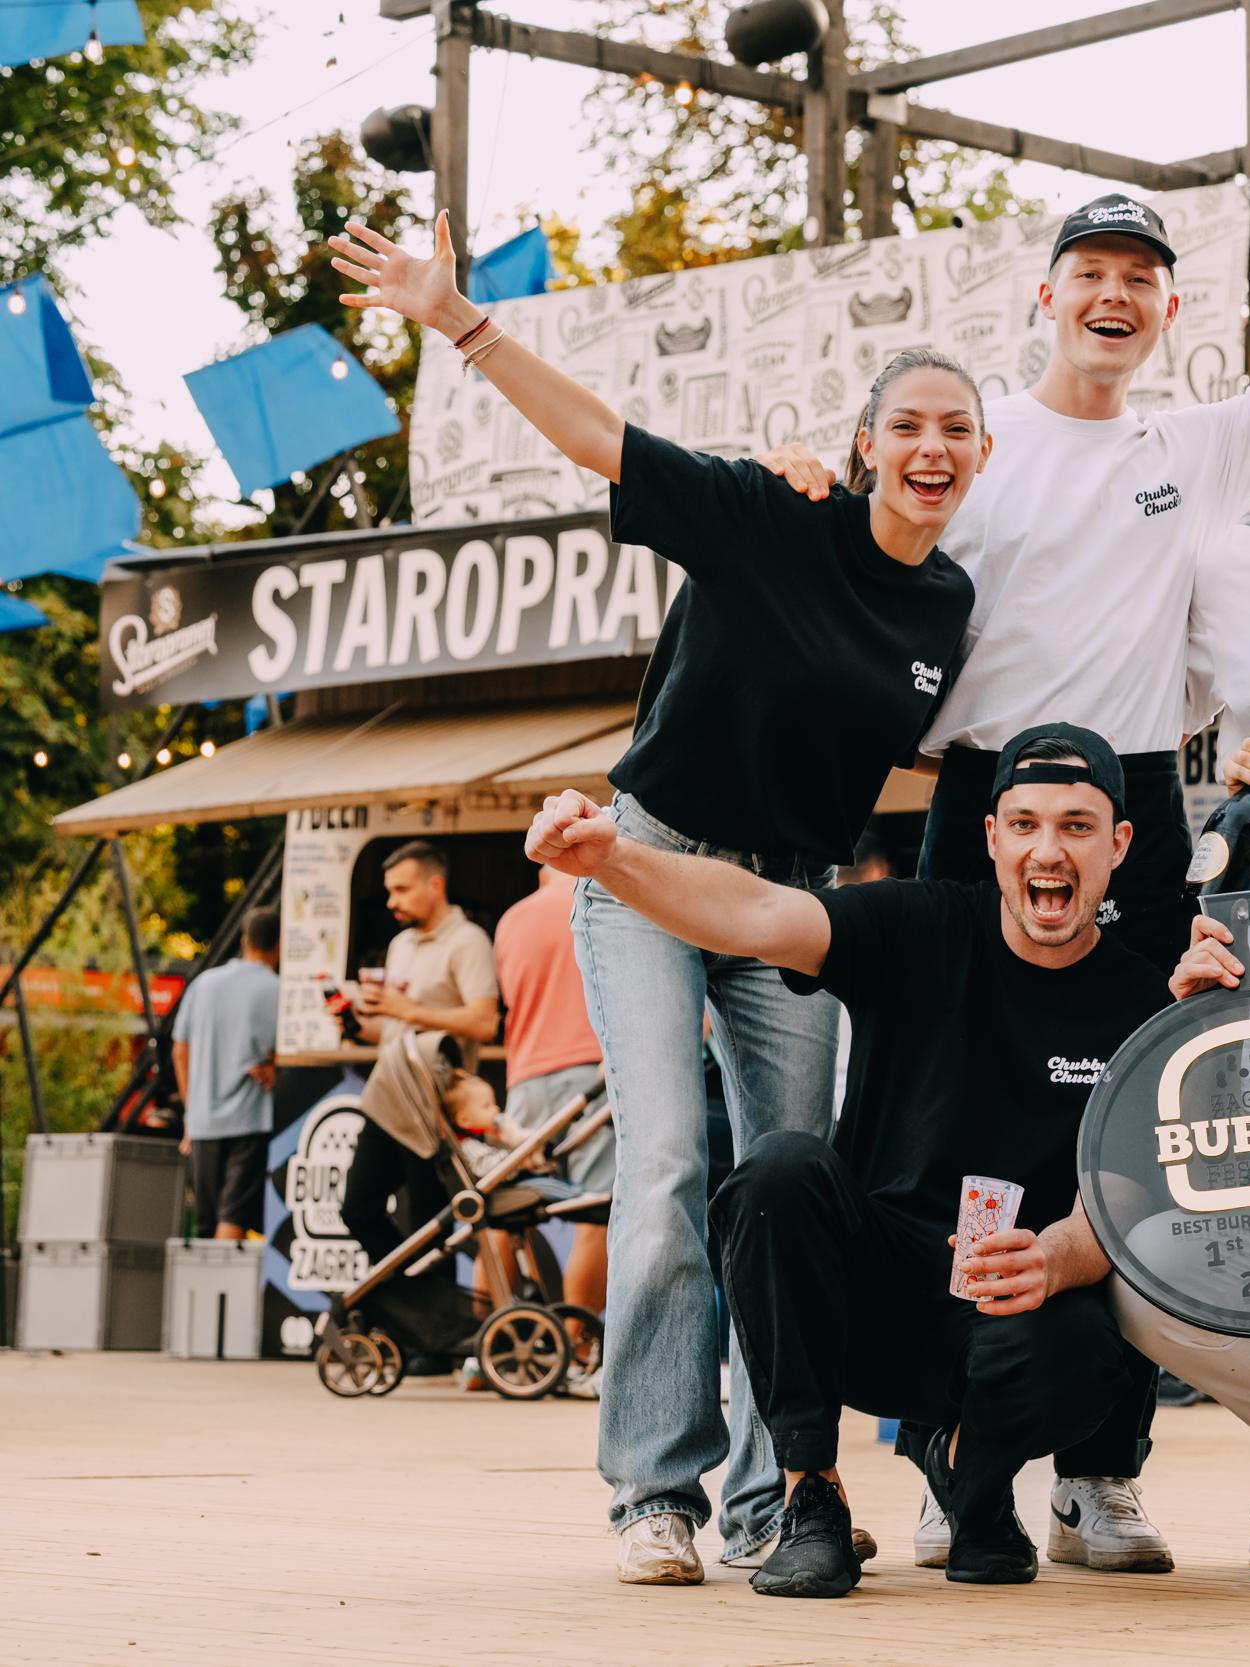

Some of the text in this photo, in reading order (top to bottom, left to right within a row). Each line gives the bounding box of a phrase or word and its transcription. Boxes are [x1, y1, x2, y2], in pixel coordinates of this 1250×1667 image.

[1088, 201, 1145, 219] Chubby
[247, 528, 688, 683] STAROPRA
[1171, 1219, 1212, 1236] BEST
[1204, 1235, 1244, 1268] 1st
